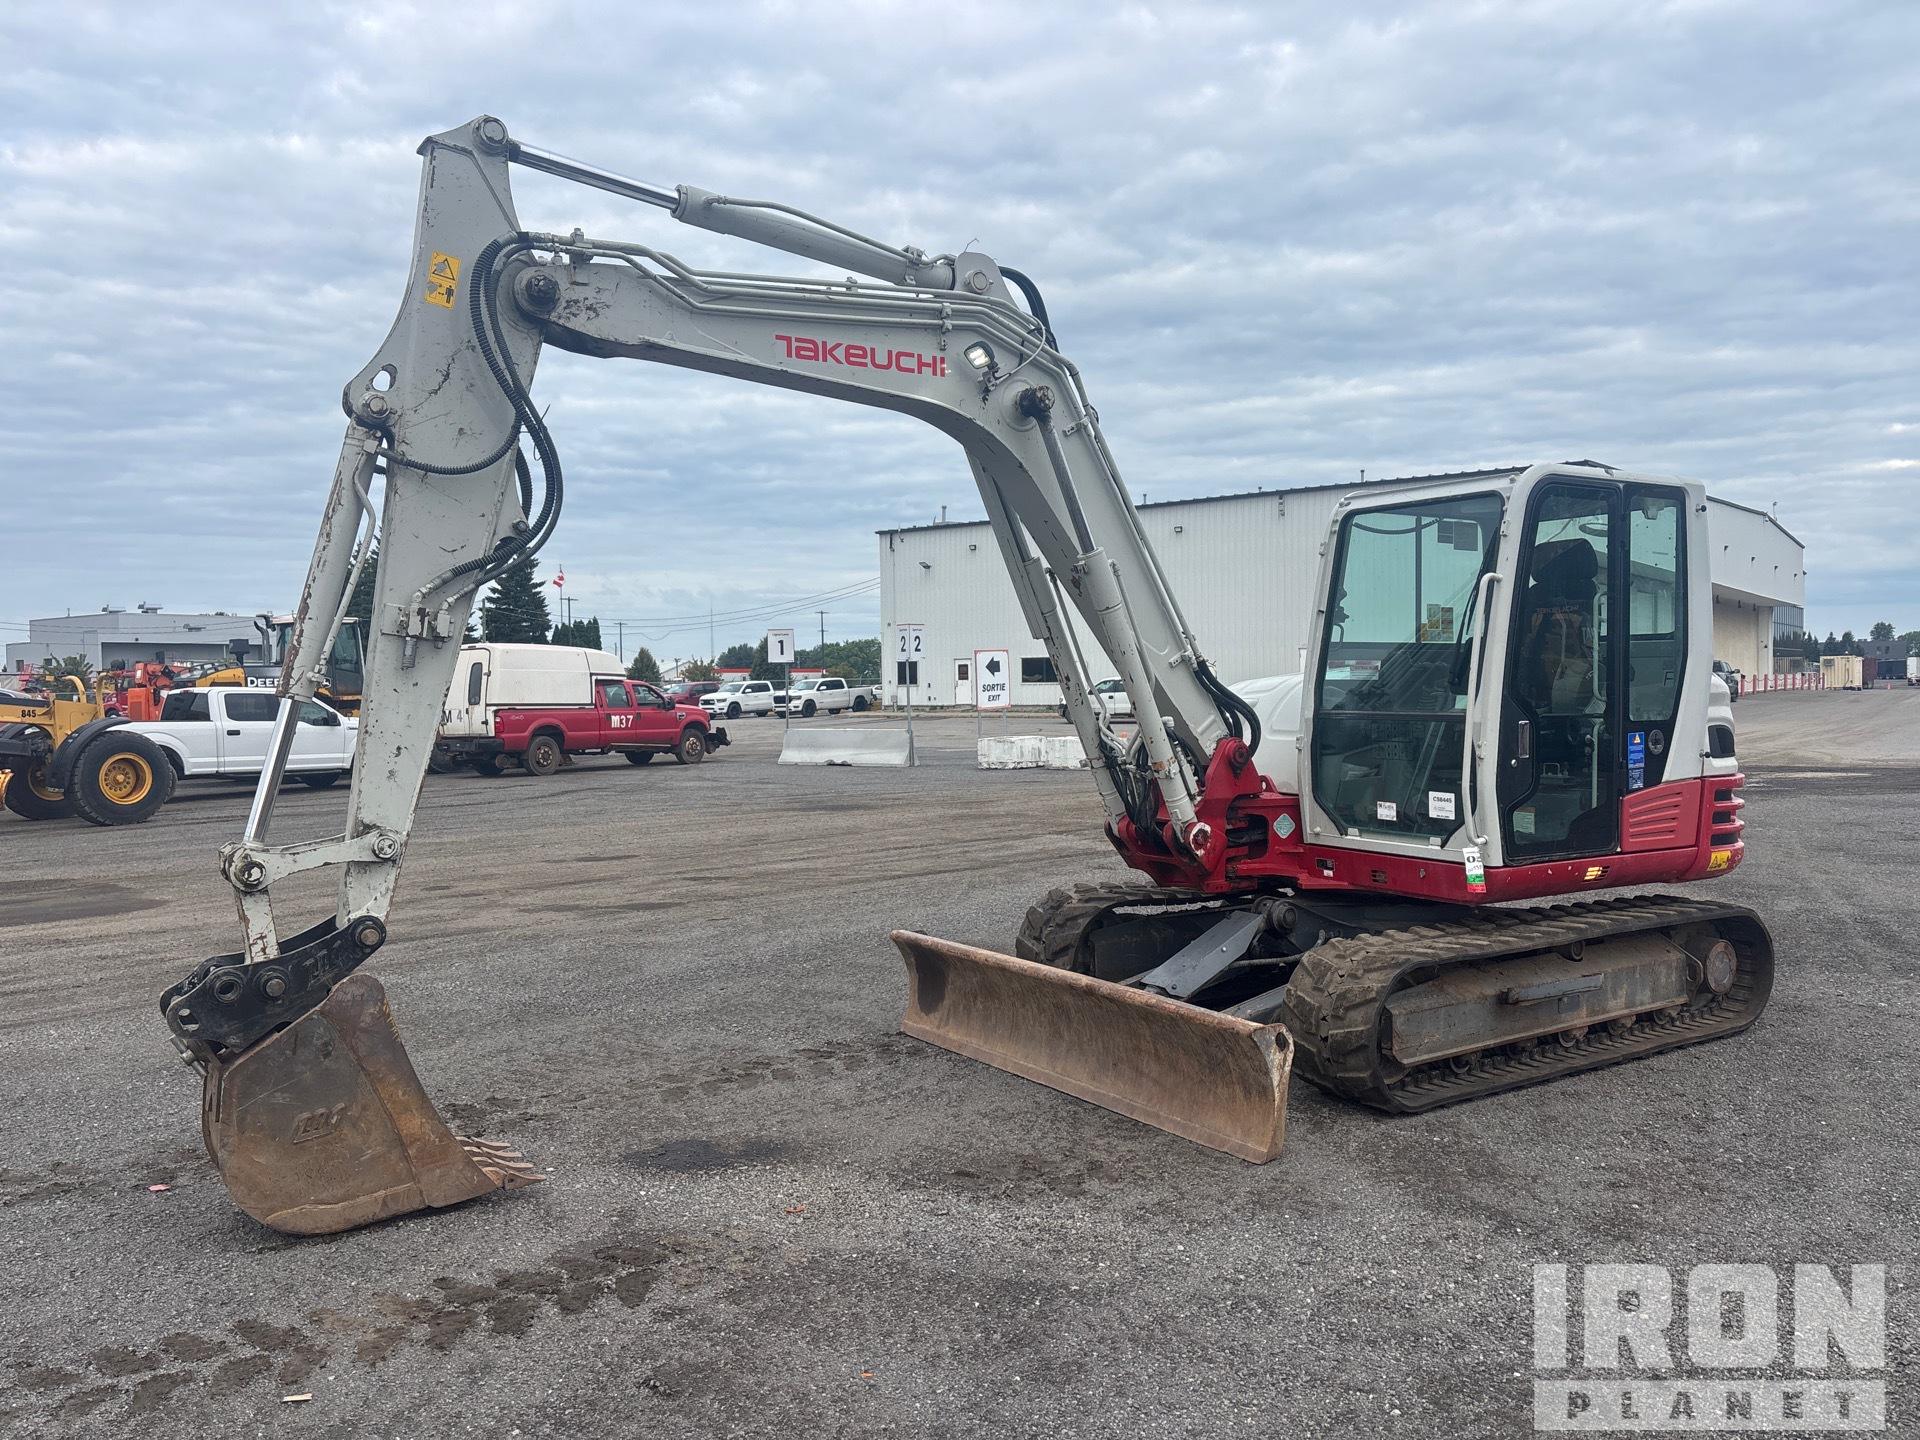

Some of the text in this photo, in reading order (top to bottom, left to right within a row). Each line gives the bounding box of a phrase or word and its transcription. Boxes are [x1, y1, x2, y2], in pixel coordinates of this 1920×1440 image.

[775, 334, 946, 377] TAKEUCHI
[777, 639, 784, 656] 1
[900, 635, 906, 653] 2
[914, 635, 921, 653] 2
[982, 683, 1006, 692] SORTIE
[21, 709, 37, 718] 845
[611, 714, 634, 729] M37
